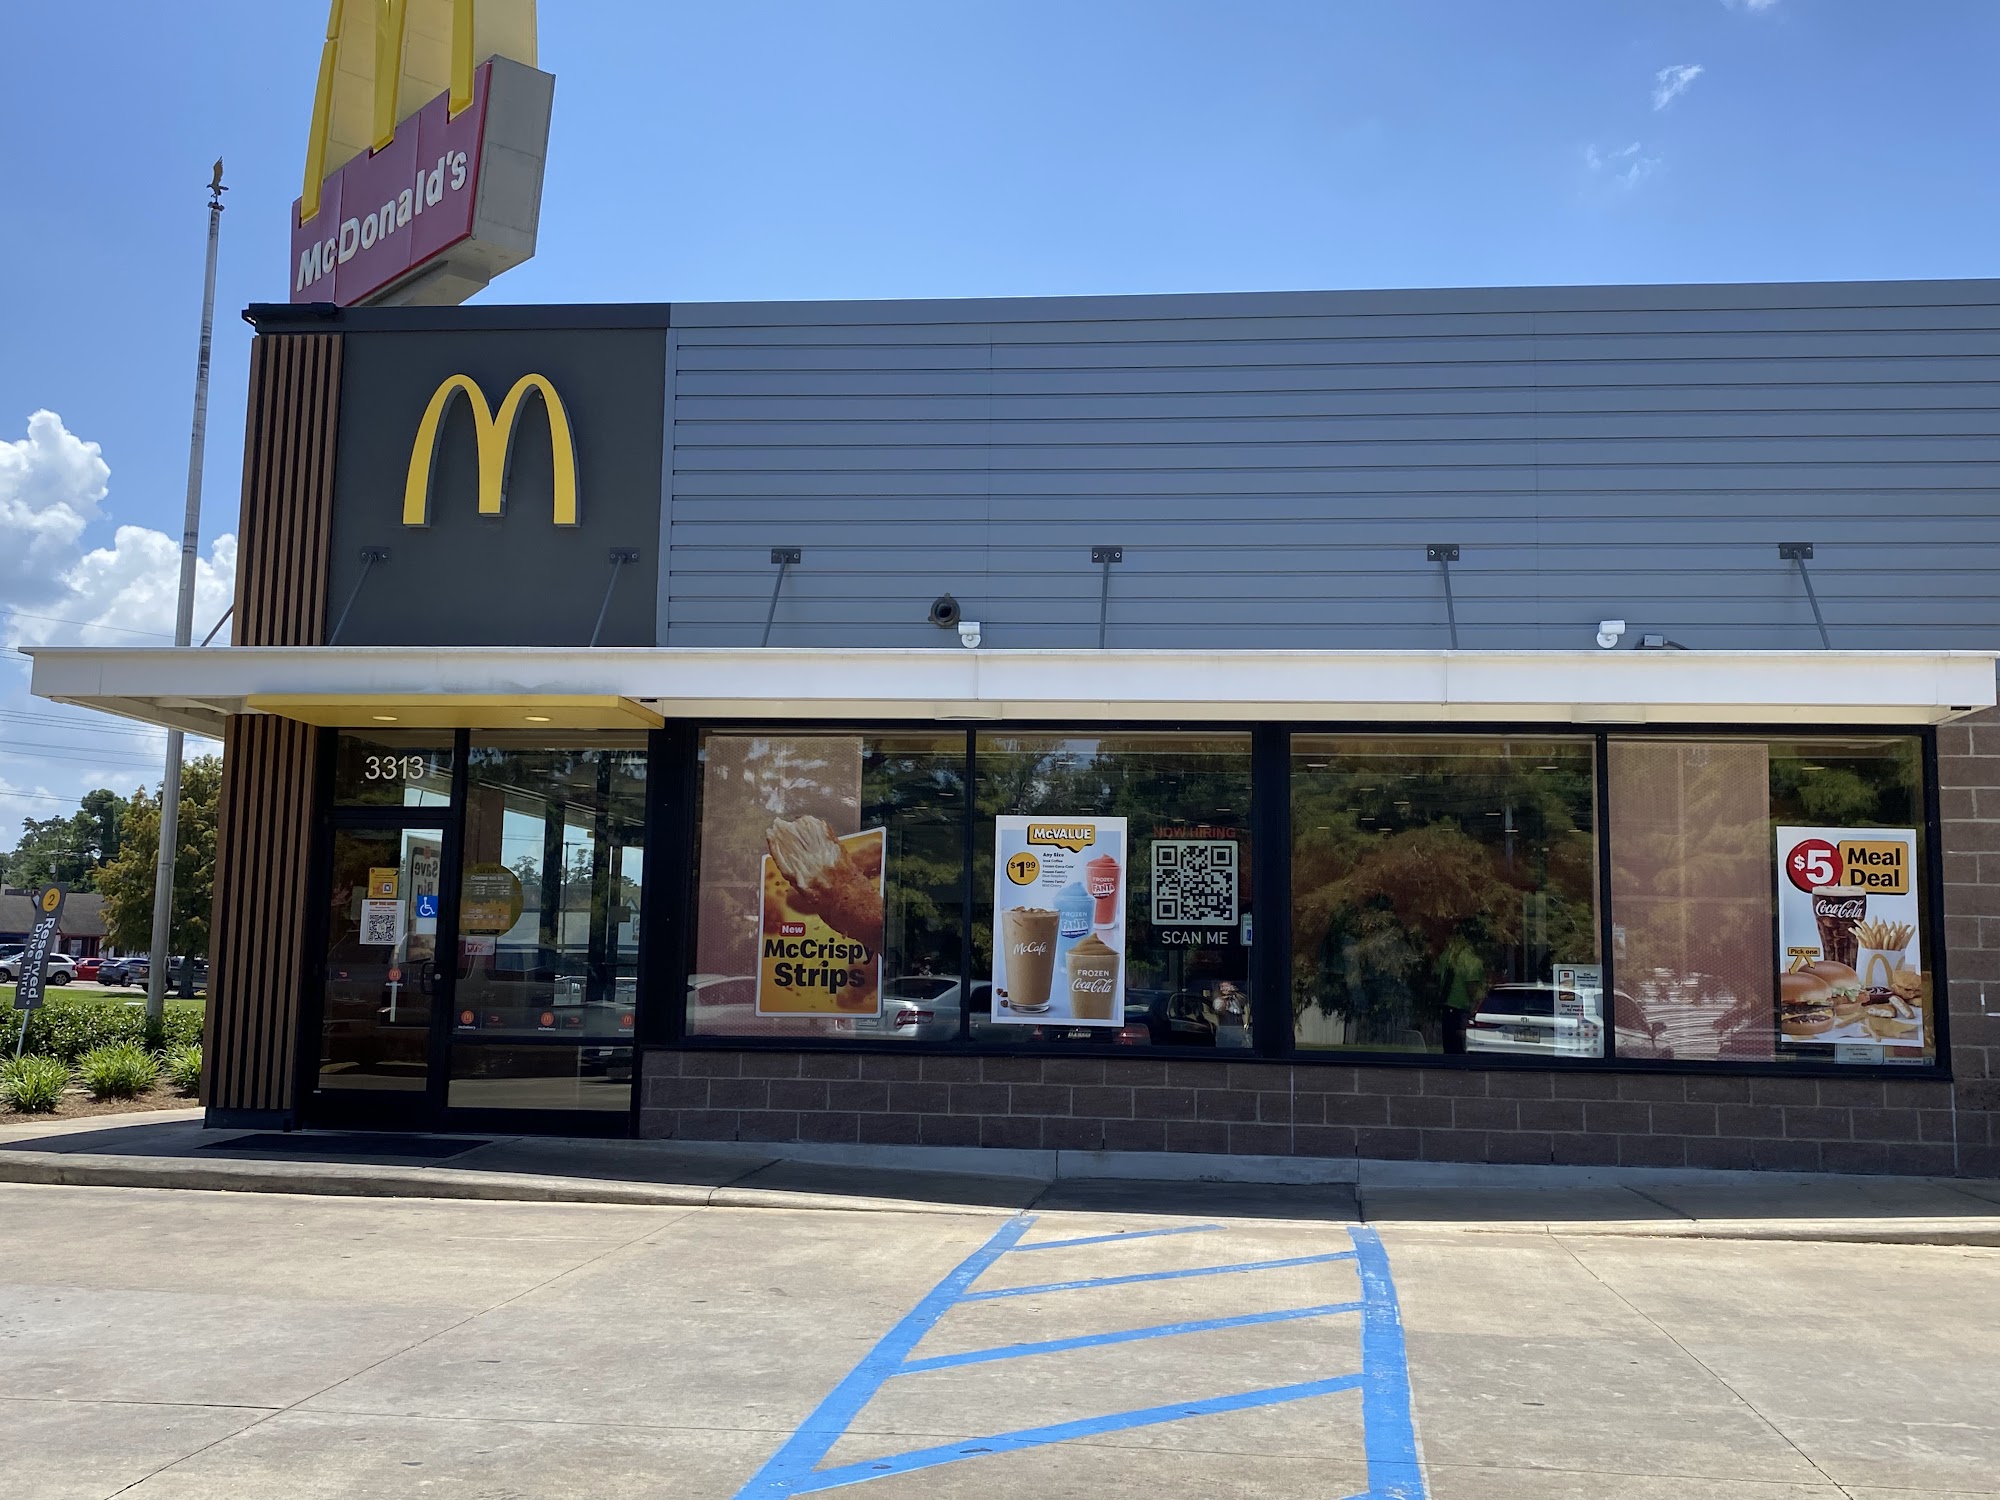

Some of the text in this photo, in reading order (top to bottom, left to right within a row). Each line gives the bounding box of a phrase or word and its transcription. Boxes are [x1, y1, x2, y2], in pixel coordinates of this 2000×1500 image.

[296, 150, 467, 292] McDonald's
[364, 755, 424, 780] 3313
[1033, 828, 1092, 840] McVALUE
[1153, 826, 1237, 838] NOW HIRING
[1847, 847, 1901, 866] Meal
[1793, 849, 1834, 885] $5
[1850, 868, 1900, 887] Deal
[1092, 883, 1115, 892] FANTA
[47, 894, 55, 907] 2
[781, 925, 804, 934] New
[1061, 919, 1089, 930] FANTA
[1161, 931, 1229, 945] SCAN ME
[20, 923, 44, 996] Drive Thru
[27, 917, 56, 1000] Reserved
[764, 937, 875, 965] McCrispy
[773, 960, 866, 994] Strips
[1077, 969, 1110, 977] FROZEN
